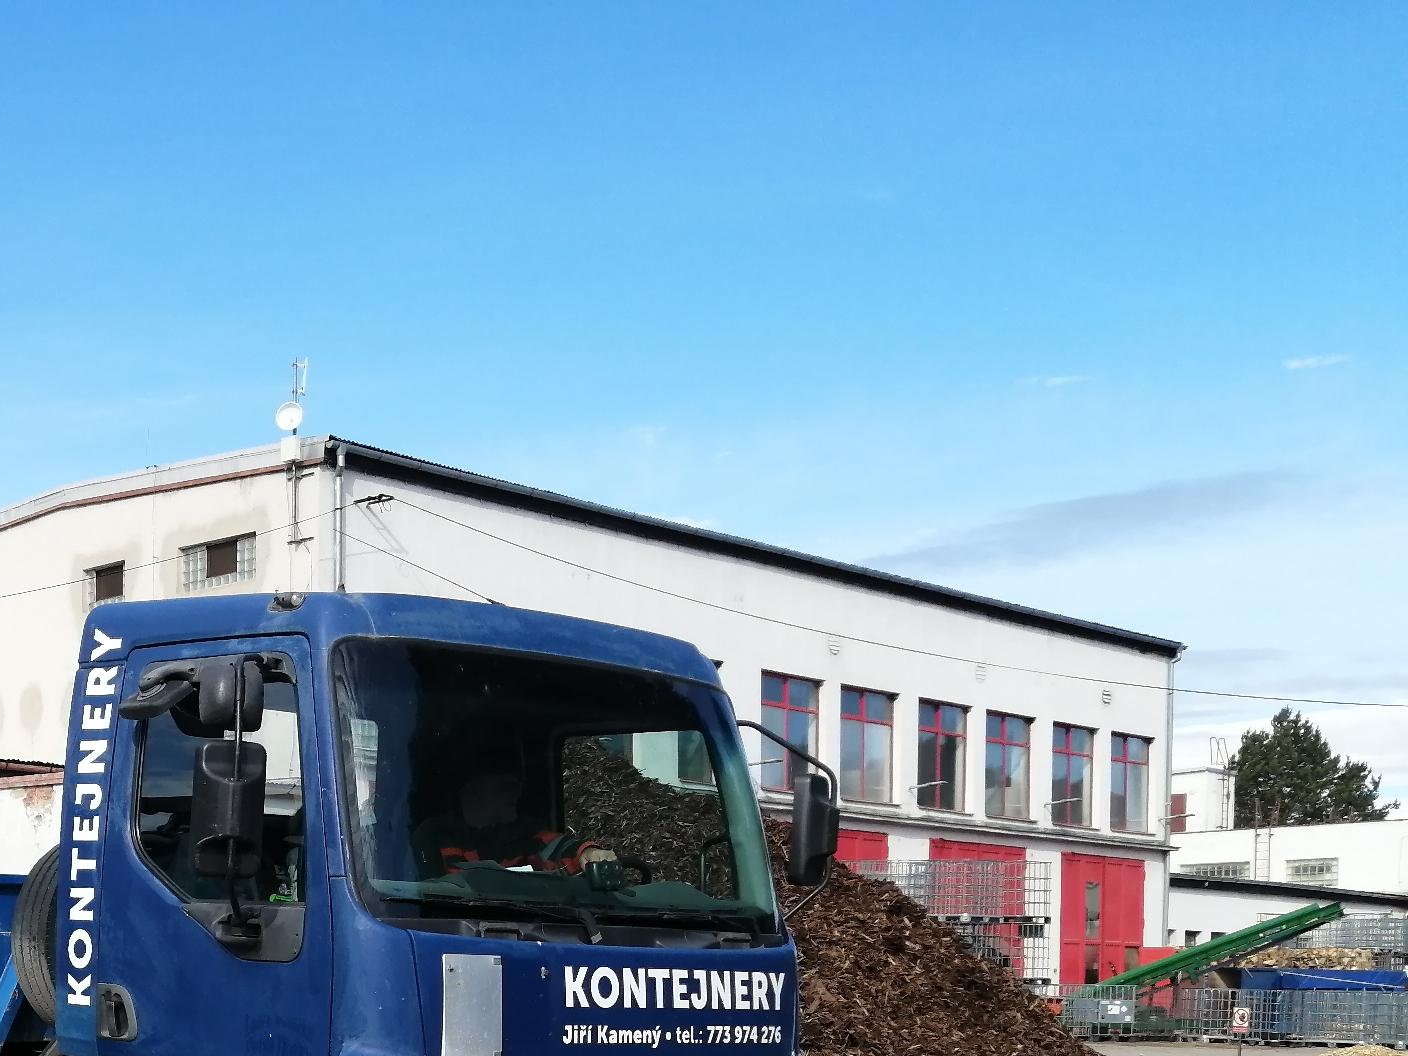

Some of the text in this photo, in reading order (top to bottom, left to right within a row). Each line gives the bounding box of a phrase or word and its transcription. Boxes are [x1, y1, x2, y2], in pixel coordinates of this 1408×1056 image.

[67, 628, 124, 1007] KONTEJNERY
[563, 966, 786, 1011] KONTEJNERY
[562, 1025, 782, 1049] Jiří Kamený tel.: 773 974 276
